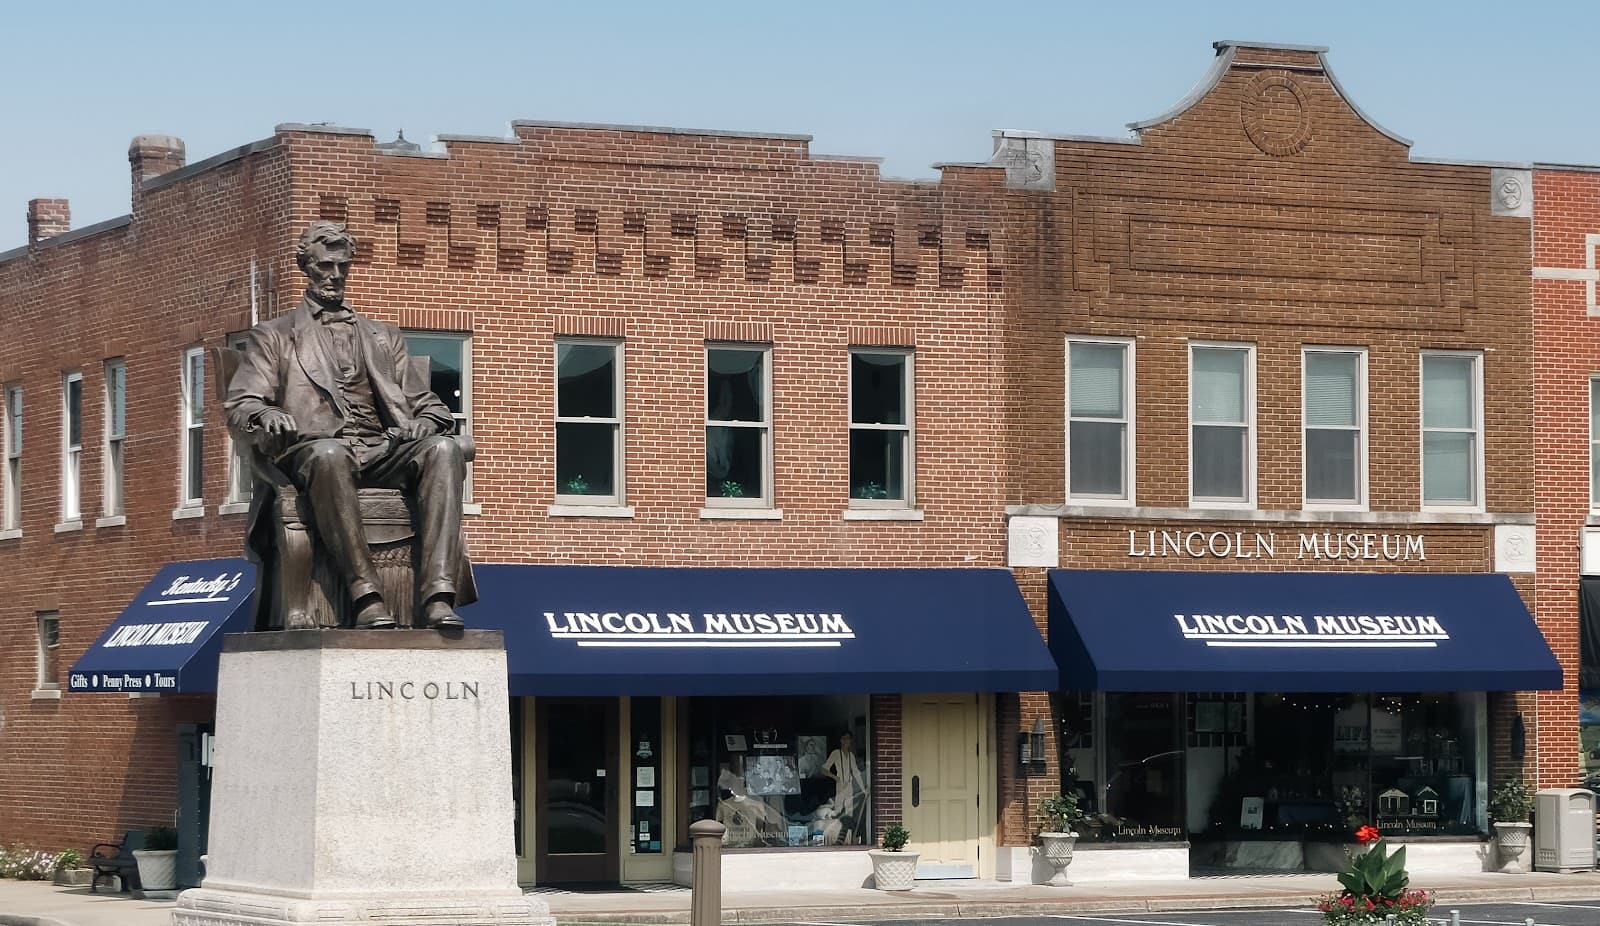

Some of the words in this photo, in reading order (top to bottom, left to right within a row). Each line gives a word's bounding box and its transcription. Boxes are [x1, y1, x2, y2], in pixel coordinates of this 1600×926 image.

[1128, 530, 1275, 558] LINCOLN
[1297, 533, 1426, 561] MUSEUM
[161, 572, 243, 597] Kentucky's
[103, 623, 162, 648] LINCOLN
[146, 621, 210, 645] MUSEUM
[544, 612, 695, 634] LINCOLN
[703, 613, 853, 635] MUSEUM
[1175, 614, 1310, 635] LINCOLN
[1314, 615, 1446, 636] MUSEUM
[71, 673, 88, 688] Gifts
[103, 674, 123, 691] Penny
[124, 674, 142, 688] Press
[154, 673, 175, 687] Tours
[352, 681, 479, 701] LINCOLN
[1118, 825, 1147, 836] Lincoln
[1150, 824, 1181, 836] Museum
[1376, 819, 1404, 830] Lincoln
